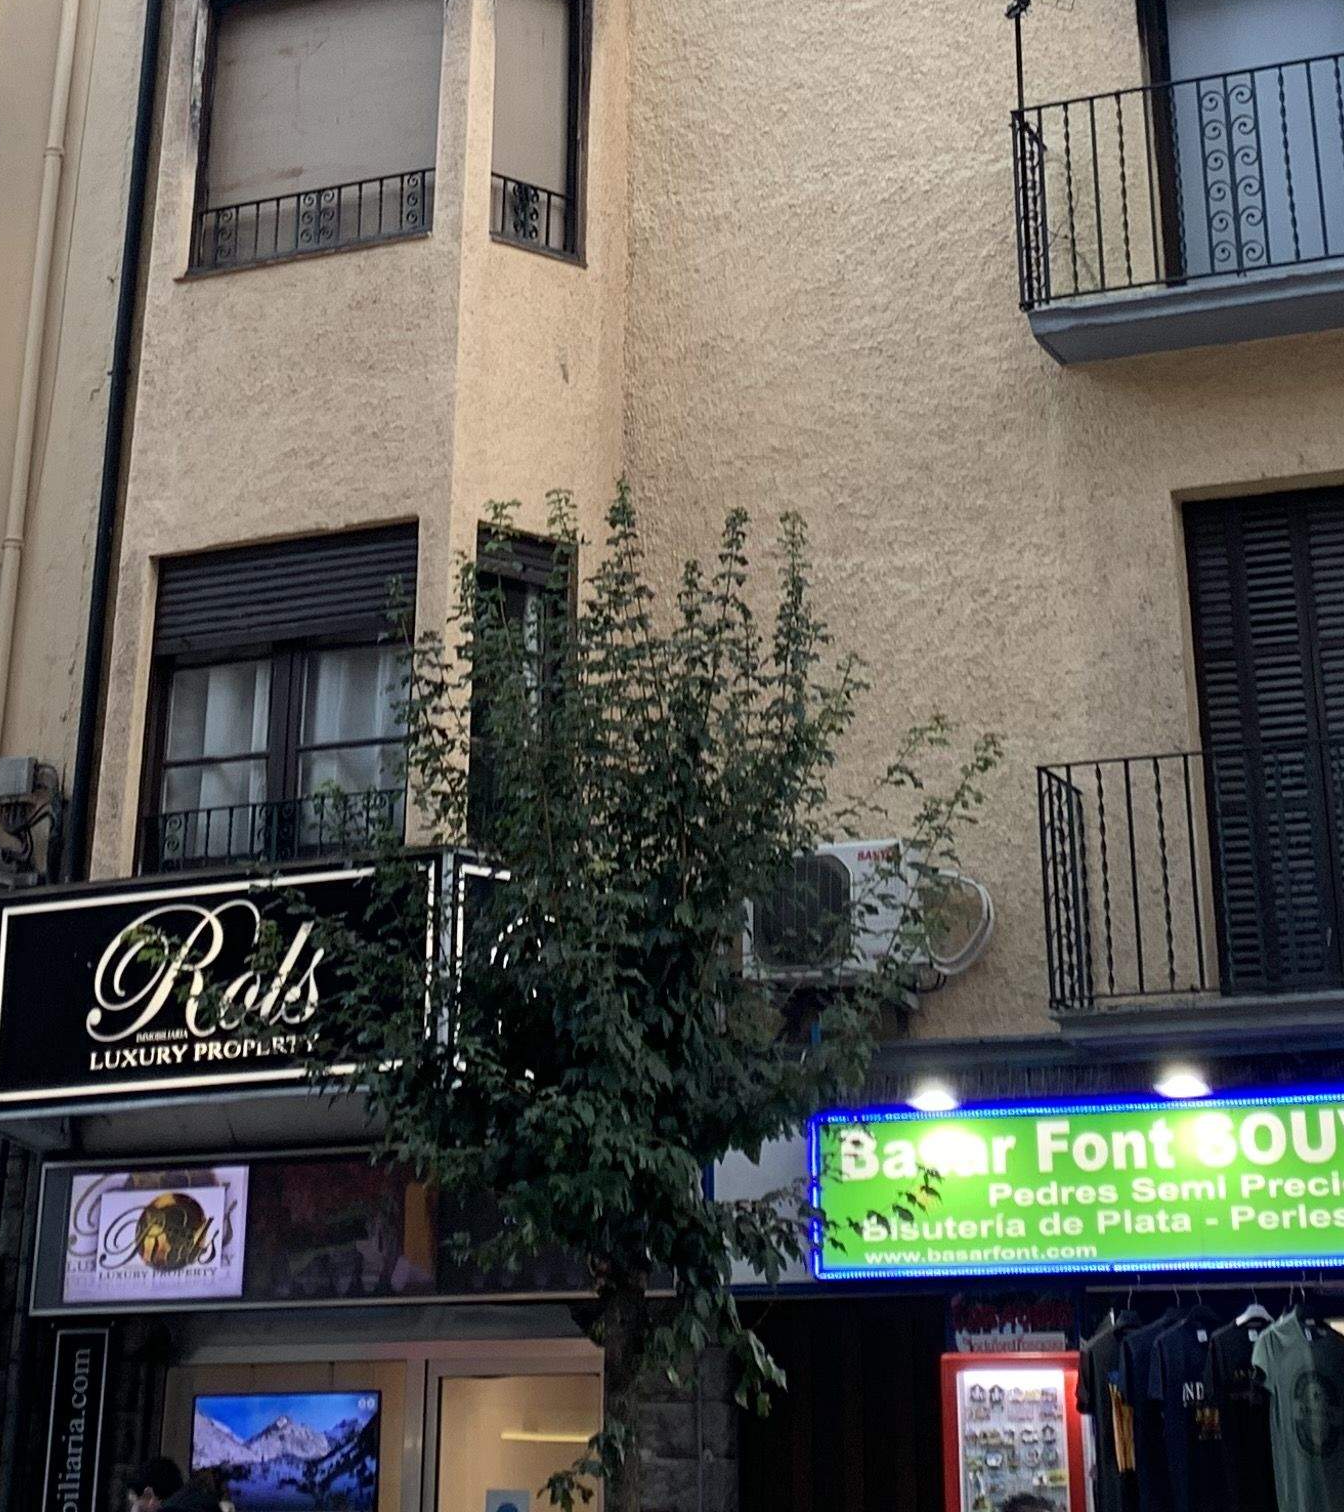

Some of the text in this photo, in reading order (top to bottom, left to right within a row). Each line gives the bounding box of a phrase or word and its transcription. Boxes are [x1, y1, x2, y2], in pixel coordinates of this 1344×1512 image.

[89, 1043, 189, 1071] LUXURY
[839, 1128, 1016, 1182] Baar
[1035, 1116, 1176, 1173] Font
[988, 1180, 1119, 1209] Pedres
[1131, 1173, 1227, 1203] Semi
[861, 1210, 1027, 1243] Bisutería
[1039, 1209, 1085, 1238] de
[1097, 1207, 1192, 1236] Plata
[863, 1241, 1099, 1267] www.basarfont.com
